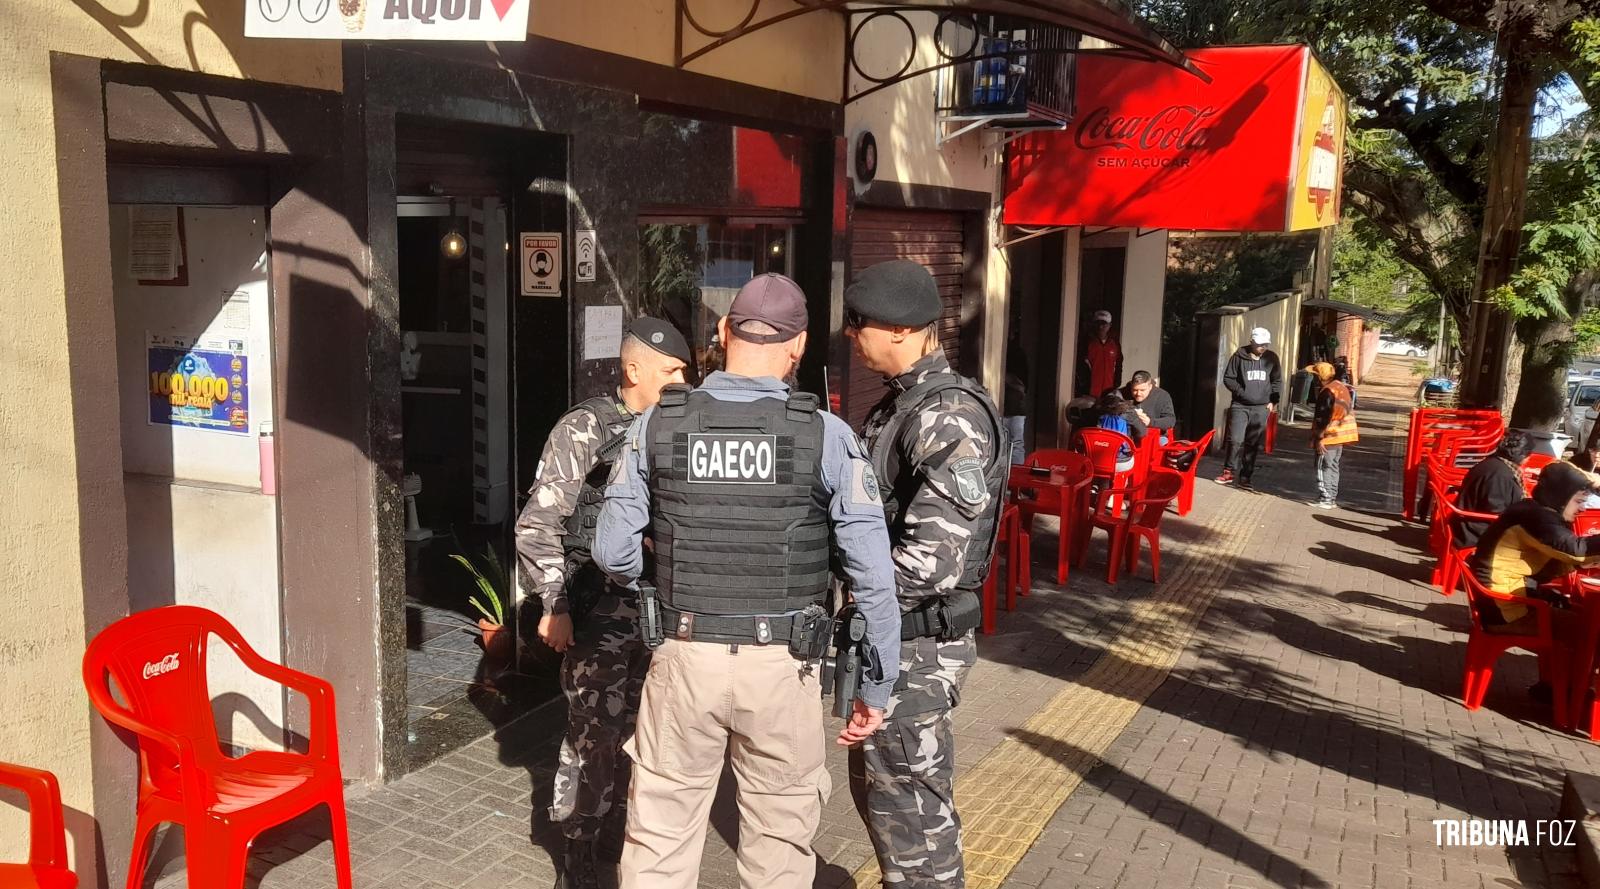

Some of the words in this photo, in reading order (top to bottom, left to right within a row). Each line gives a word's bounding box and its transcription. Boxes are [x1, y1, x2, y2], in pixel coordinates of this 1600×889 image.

[383, 0, 480, 24] AQUI
[1097, 158, 1127, 169] SEM
[1132, 156, 1190, 170] AÇÚCAR
[526, 240, 538, 248] POR
[538, 240, 557, 248] FAVOR
[691, 440, 772, 479] GAECO
[142, 651, 180, 680] Coca-Cola
